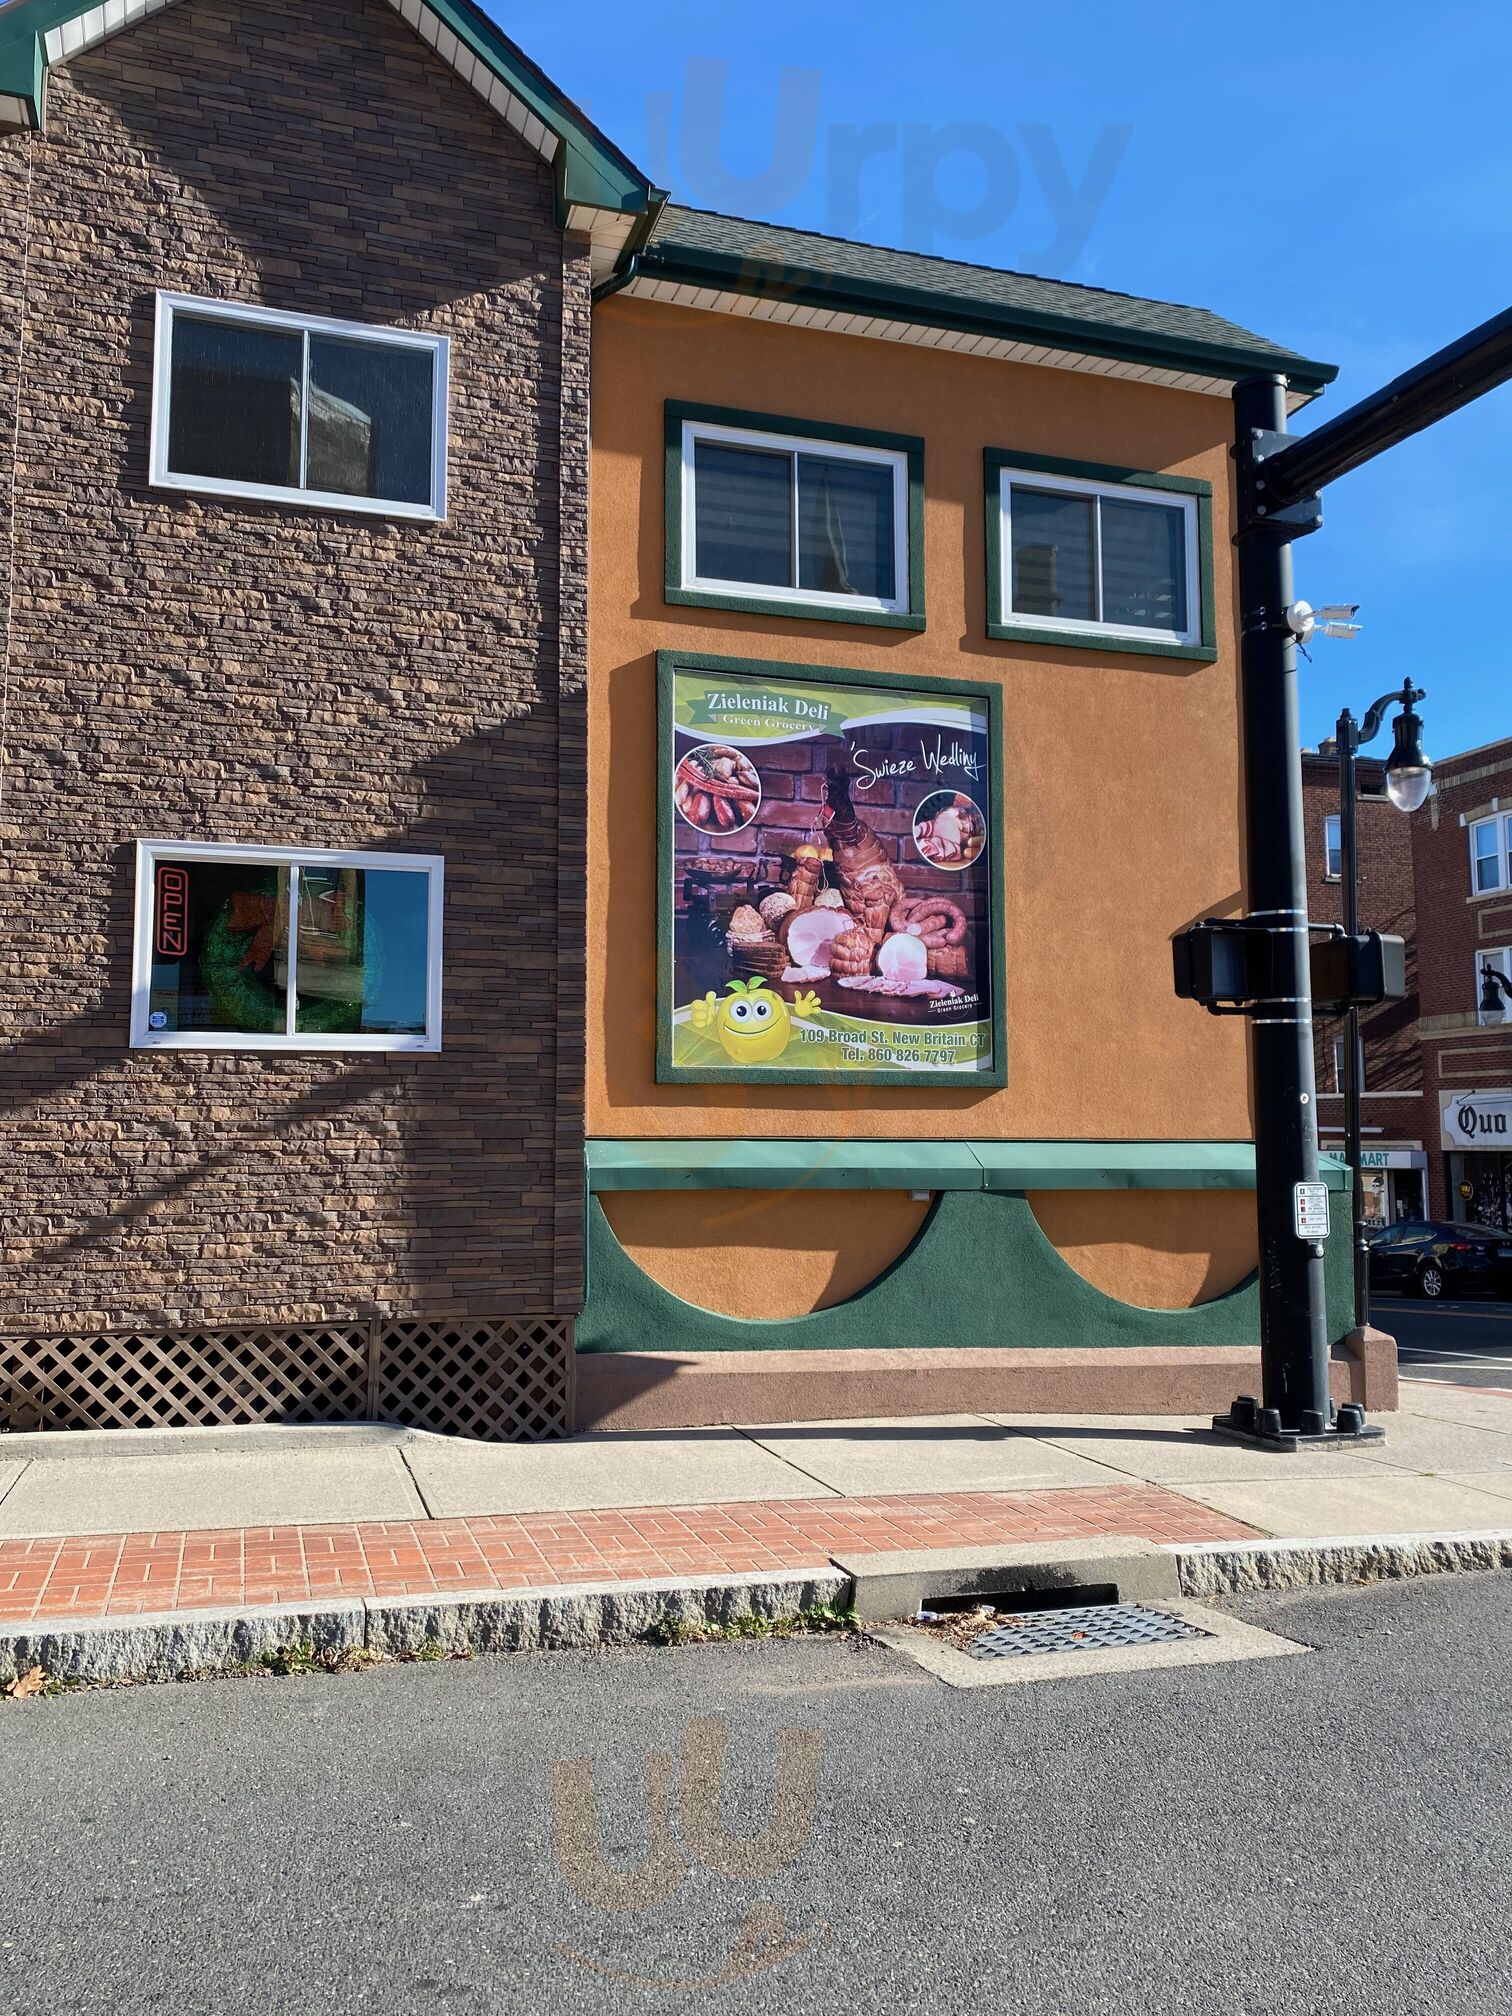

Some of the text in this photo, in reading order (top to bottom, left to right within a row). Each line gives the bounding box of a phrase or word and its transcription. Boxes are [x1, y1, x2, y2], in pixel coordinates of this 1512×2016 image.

[707, 693, 830, 721] Zieleniak Deli
[722, 714, 816, 731] Green Grocery
[920, 733, 987, 782] Wedliny
[163, 874, 183, 951] OPEN
[929, 993, 980, 1009] Zieleniak Deli
[800, 1029, 986, 1048] 109 Broad St. New Britain CT
[841, 1048, 956, 1063] Tel. 860 826 7797
[1457, 1105, 1508, 1139] Quo
